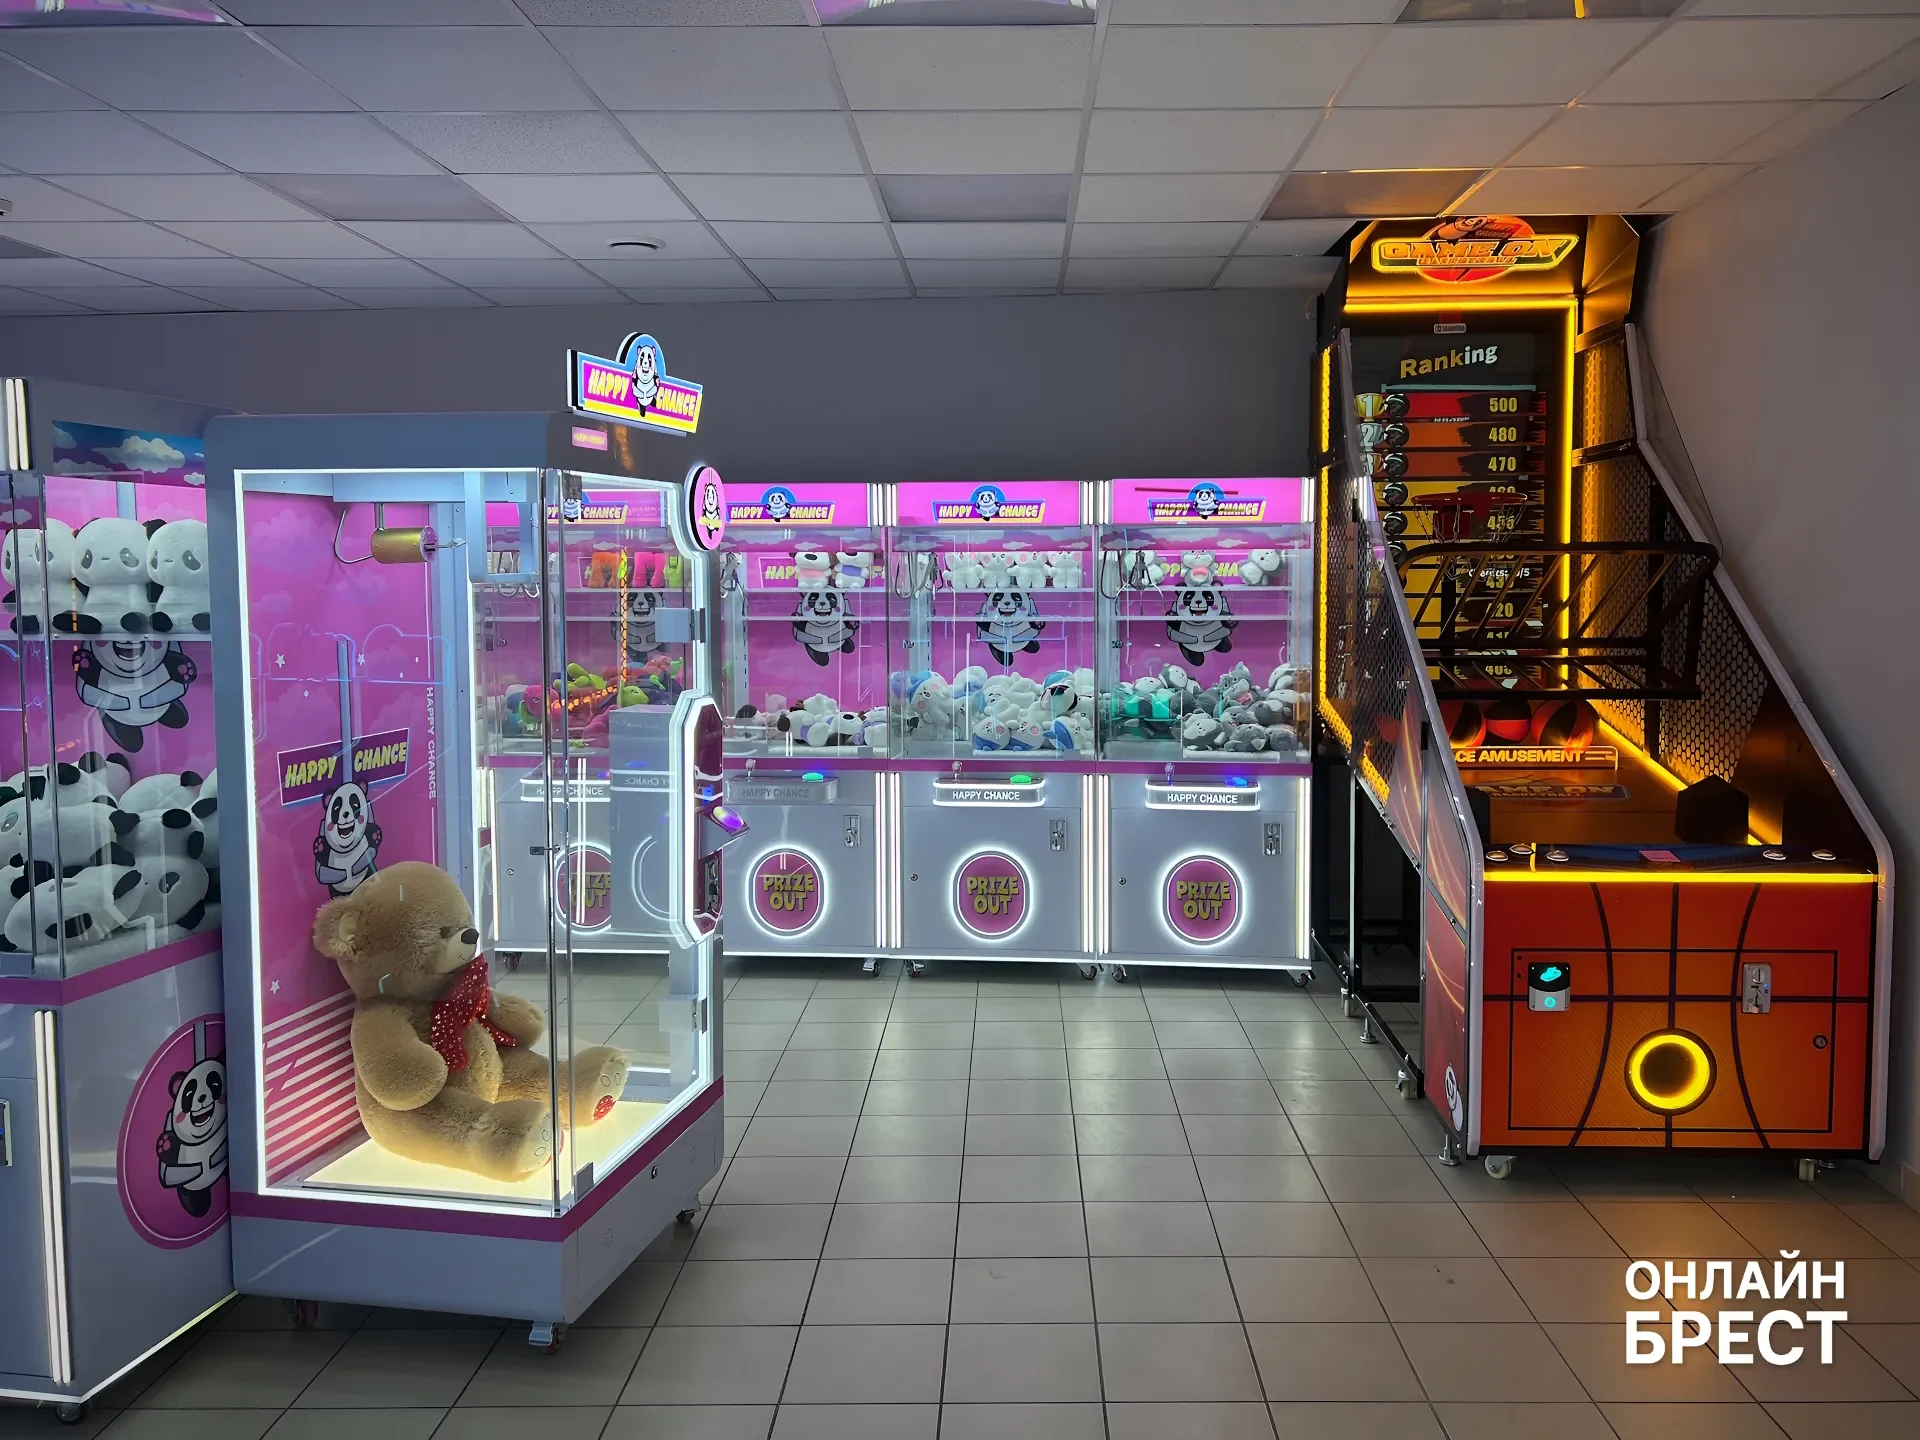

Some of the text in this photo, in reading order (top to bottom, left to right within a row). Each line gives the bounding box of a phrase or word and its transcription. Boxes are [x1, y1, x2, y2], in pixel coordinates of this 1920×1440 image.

[1382, 239, 1569, 260] GAME ON
[1400, 345, 1498, 379] Ranking
[588, 368, 697, 417] HAPPY CHANCE
[1489, 397, 1518, 412] 500
[1488, 427, 1517, 442] 480
[1488, 457, 1517, 471] 470
[583, 506, 621, 519] CHANCE
[730, 506, 828, 519] HAPPY CHANCE
[938, 505, 1038, 518] HAPPY CHANCE
[1154, 503, 1259, 516] HAPPY CHANCE
[765, 565, 799, 580] HAP
[426, 686, 437, 800] HAPPY CHANCE
[1454, 750, 1584, 763] CE AMUSEMENT
[285, 741, 408, 788] HAPPY CHANCE
[742, 788, 810, 797] HAPPY CHANCE
[952, 790, 1020, 801] HAPPY CHANCE
[1475, 785, 1552, 793] AME
[1167, 793, 1238, 804] HAPPY CHANCE
[763, 874, 815, 893] PRIZE
[966, 876, 1019, 896] PRIZE
[1176, 880, 1231, 901] PRIZE
[769, 892, 808, 911] OUT
[973, 895, 1012, 915] OUT
[1183, 900, 1224, 920] OUT
